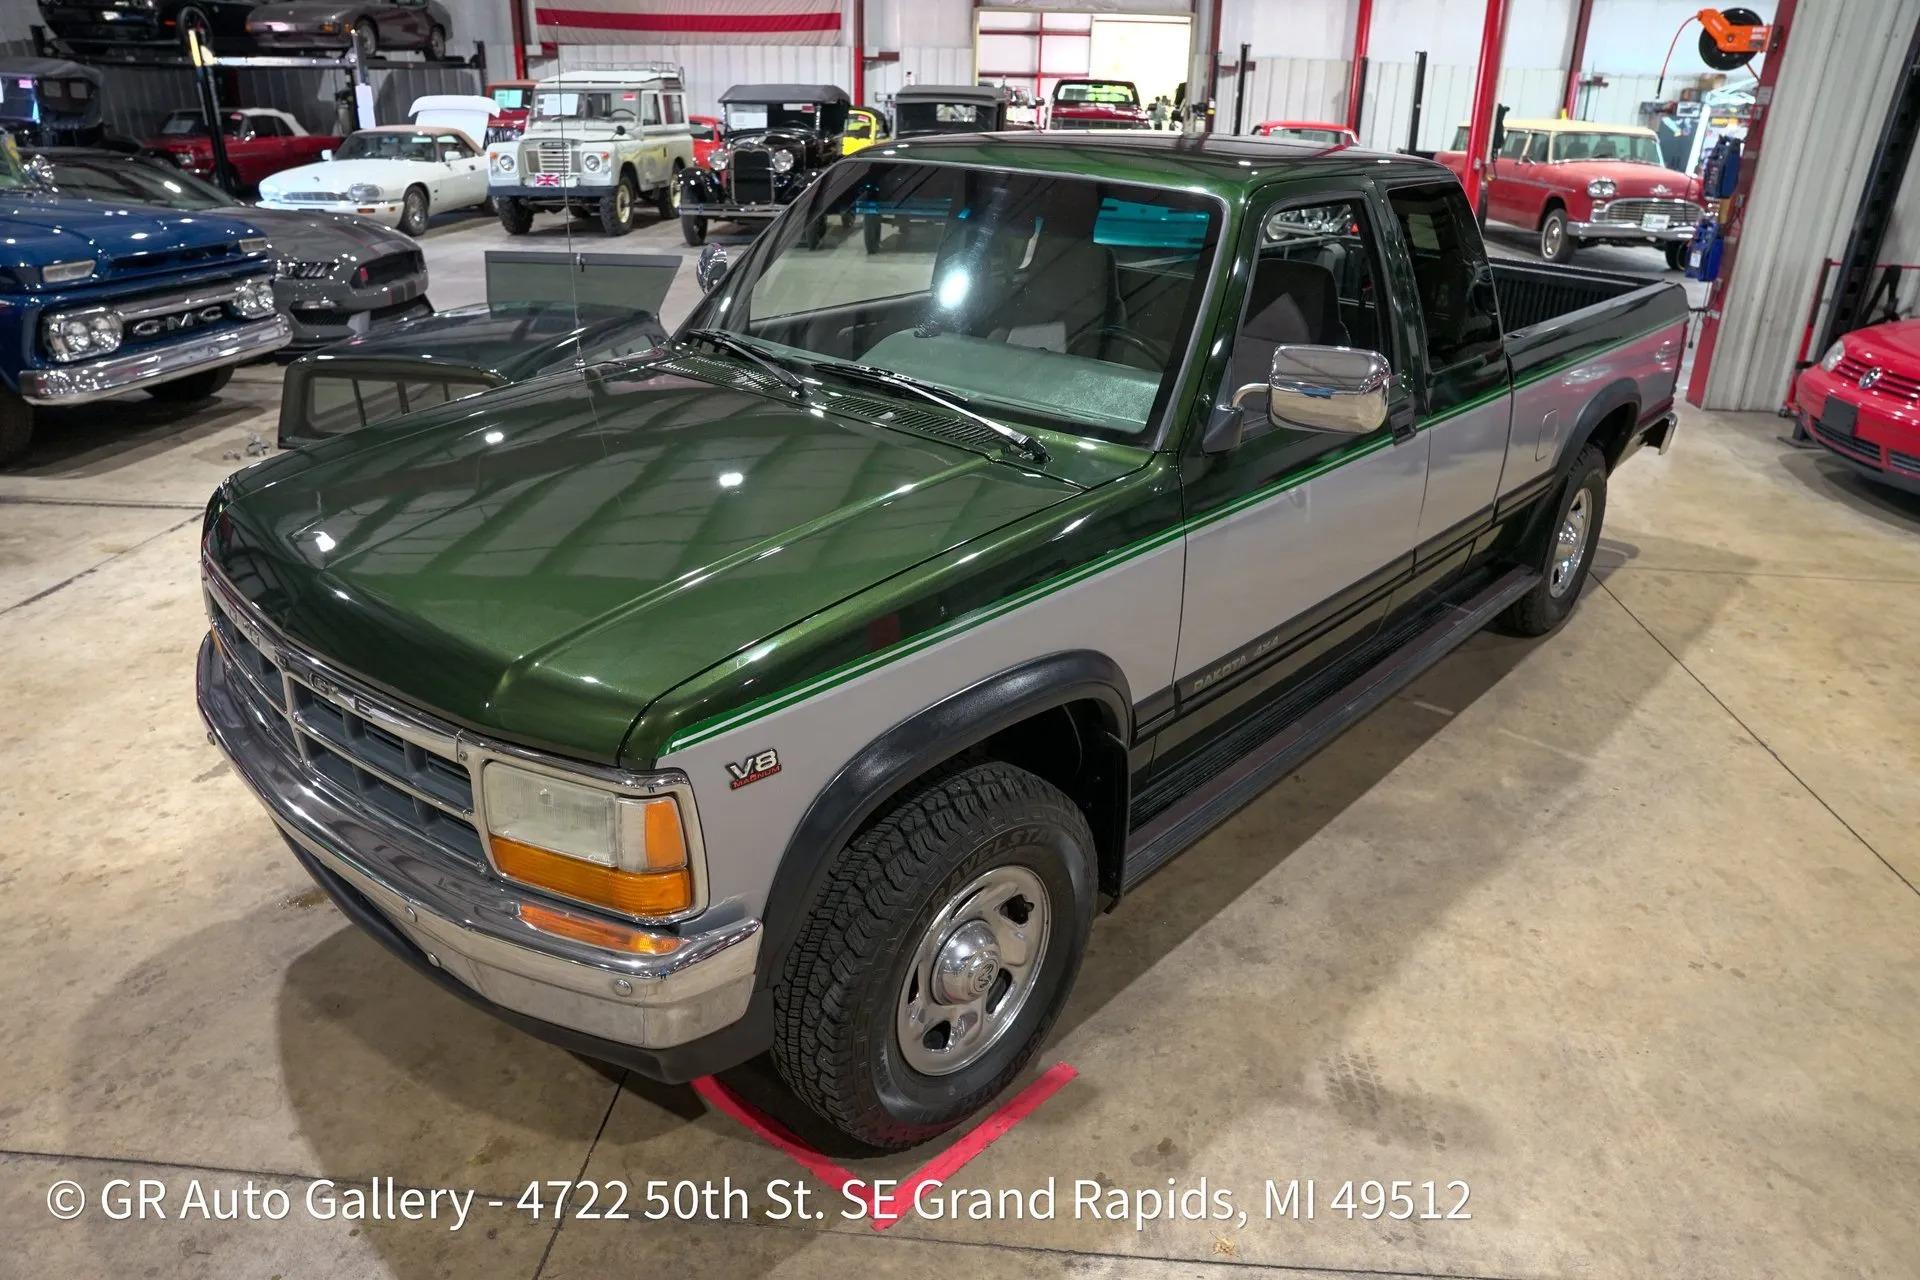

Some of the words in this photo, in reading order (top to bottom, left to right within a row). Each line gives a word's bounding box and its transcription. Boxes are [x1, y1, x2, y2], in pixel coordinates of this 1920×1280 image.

[132, 305, 223, 336] GMC
[1193, 655, 1249, 693] DAKOTA
[728, 749, 778, 780] V8
[732, 765, 781, 788] MAGNUM
